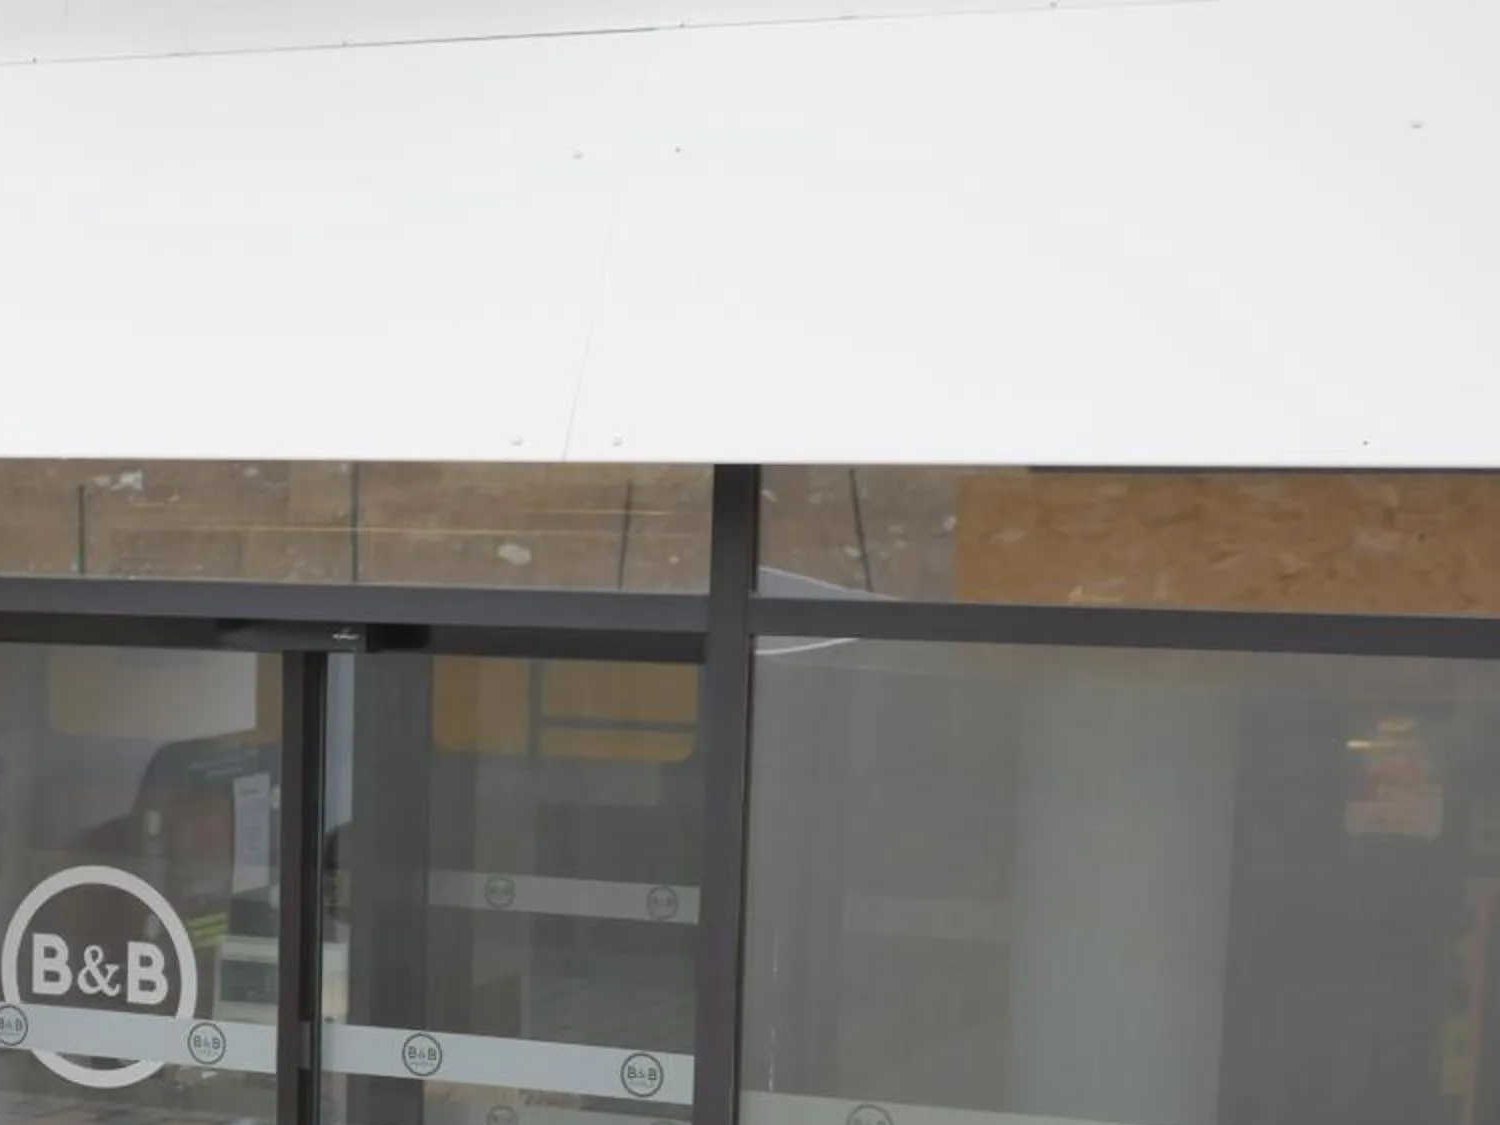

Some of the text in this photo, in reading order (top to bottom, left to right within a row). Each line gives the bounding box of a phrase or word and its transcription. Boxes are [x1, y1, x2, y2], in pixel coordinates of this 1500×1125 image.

[31, 933, 169, 1005] B&B
[194, 1035, 221, 1051] B&B
[407, 1045, 437, 1061] B&B
[628, 1065, 658, 1081] B&B
